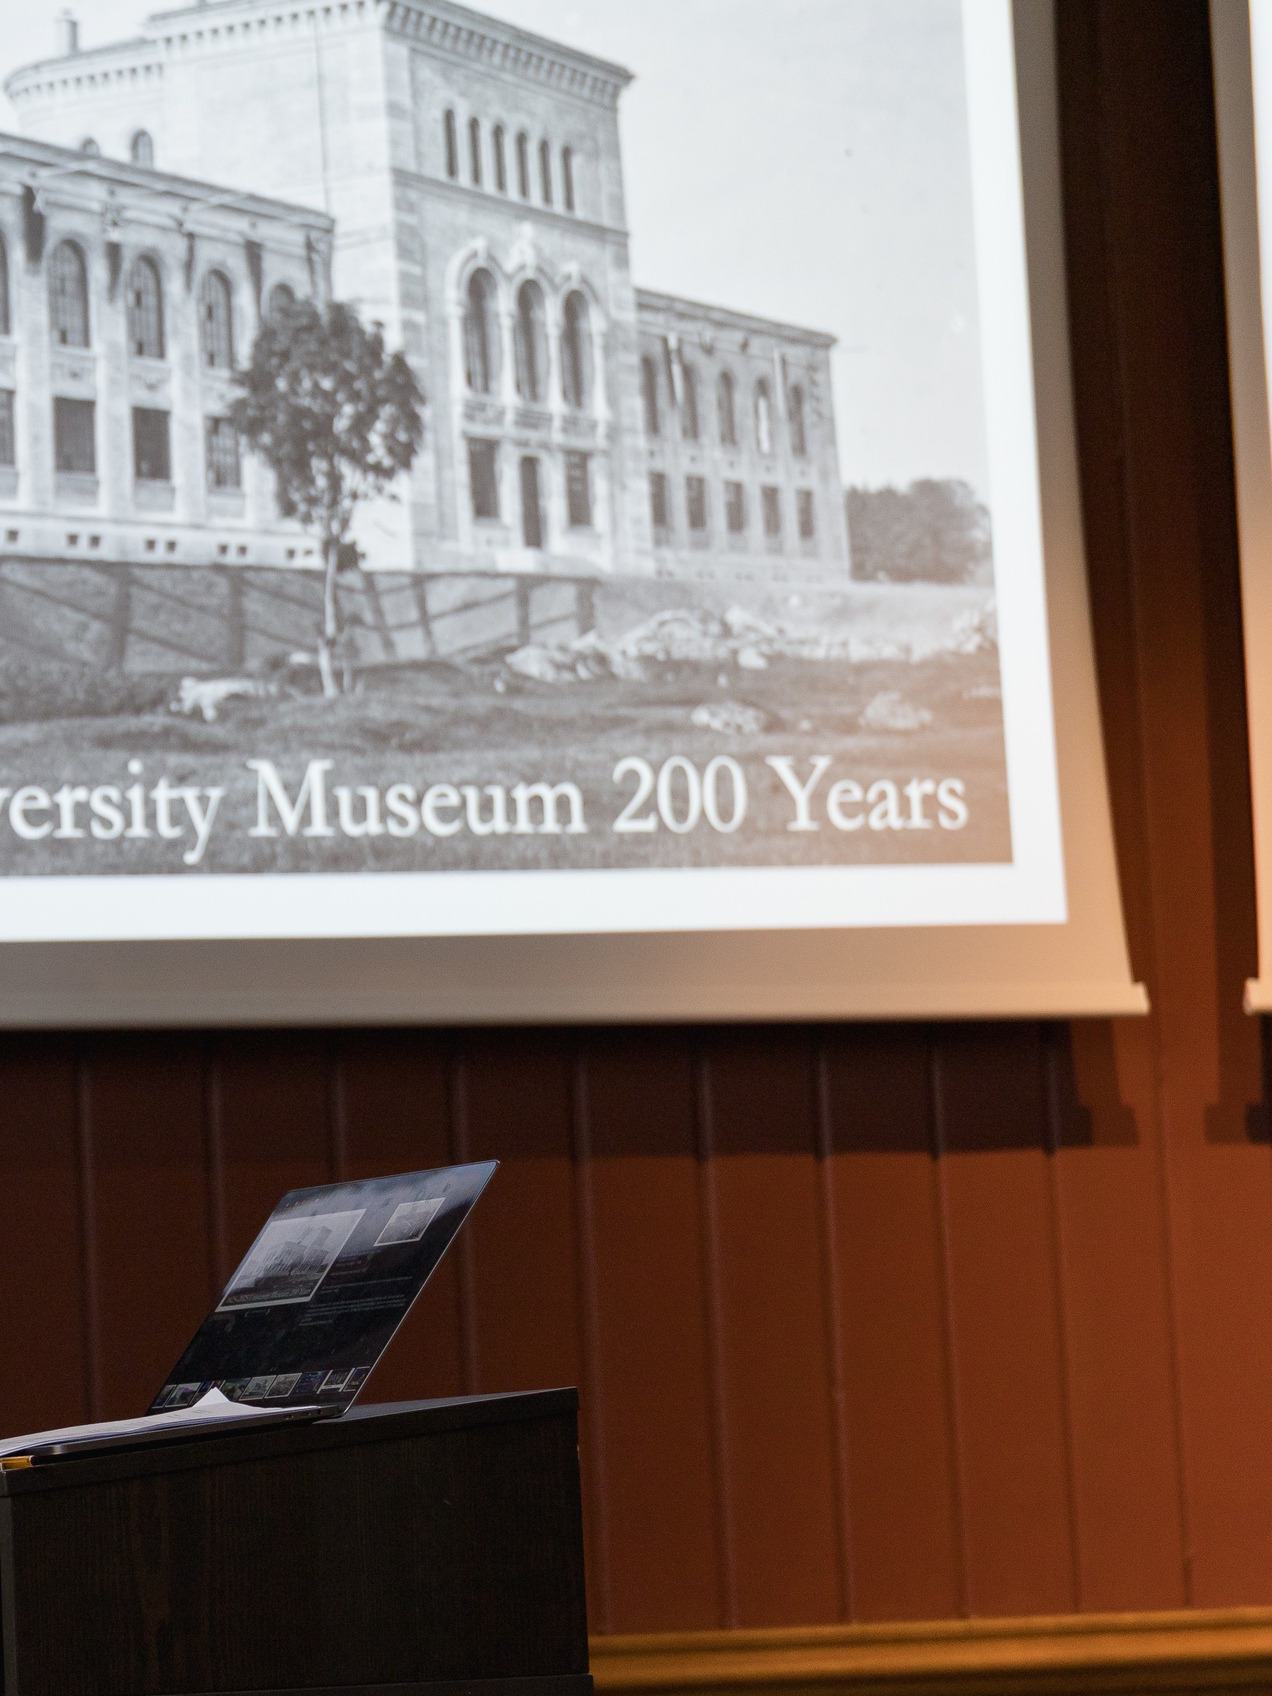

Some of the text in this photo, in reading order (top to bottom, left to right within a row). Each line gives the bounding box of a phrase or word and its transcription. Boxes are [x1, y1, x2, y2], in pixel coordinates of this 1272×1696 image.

[247, 757, 587, 838] Museum
[612, 755, 748, 834] 200
[765, 754, 970, 832] Years
